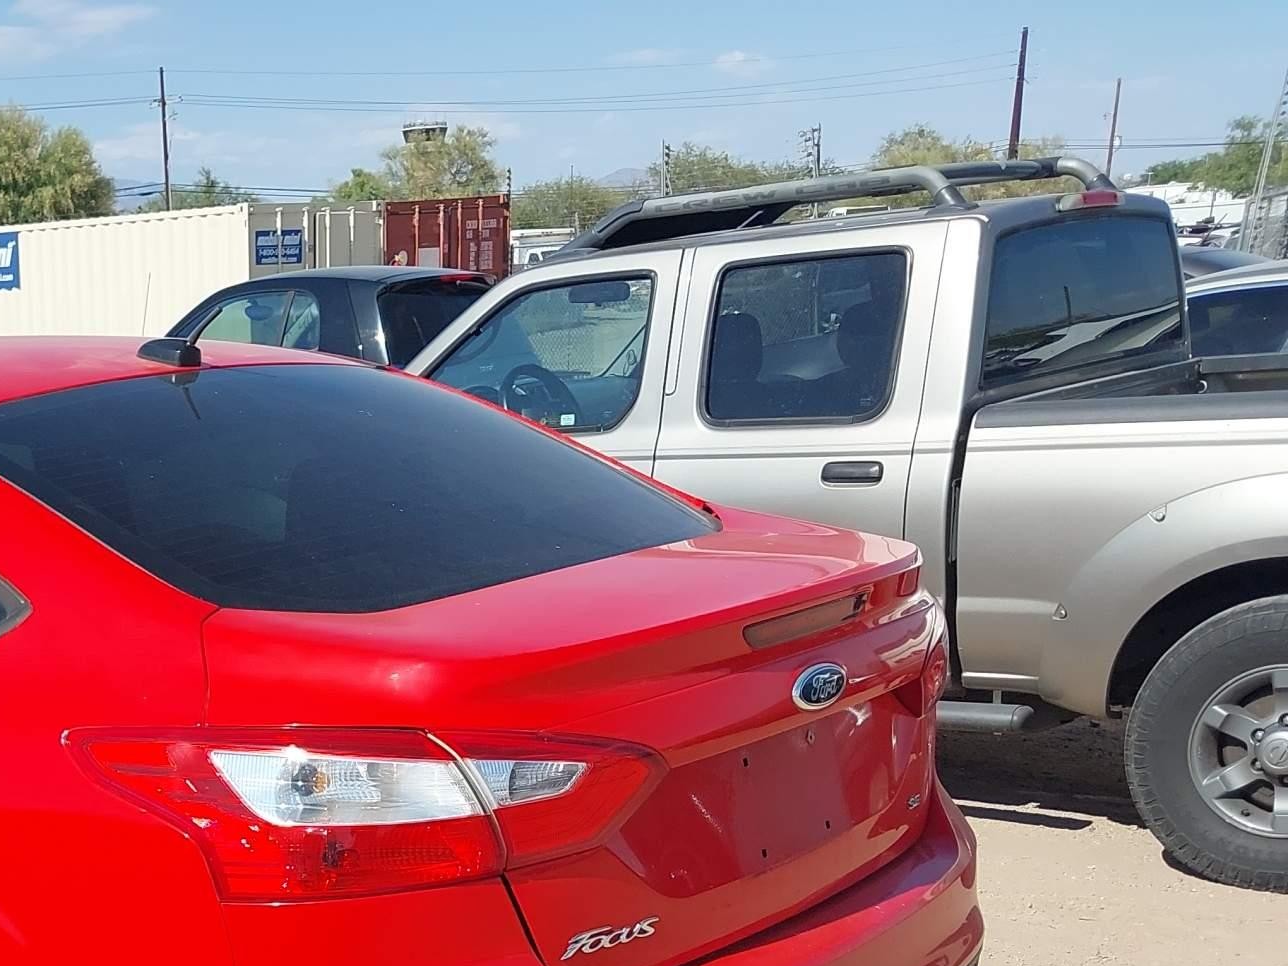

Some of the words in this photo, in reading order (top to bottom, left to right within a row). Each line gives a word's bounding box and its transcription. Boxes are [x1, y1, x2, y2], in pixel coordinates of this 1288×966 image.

[655, 190, 777, 213] CREW
[795, 176, 890, 195] CAB
[811, 672, 842, 701] Ford
